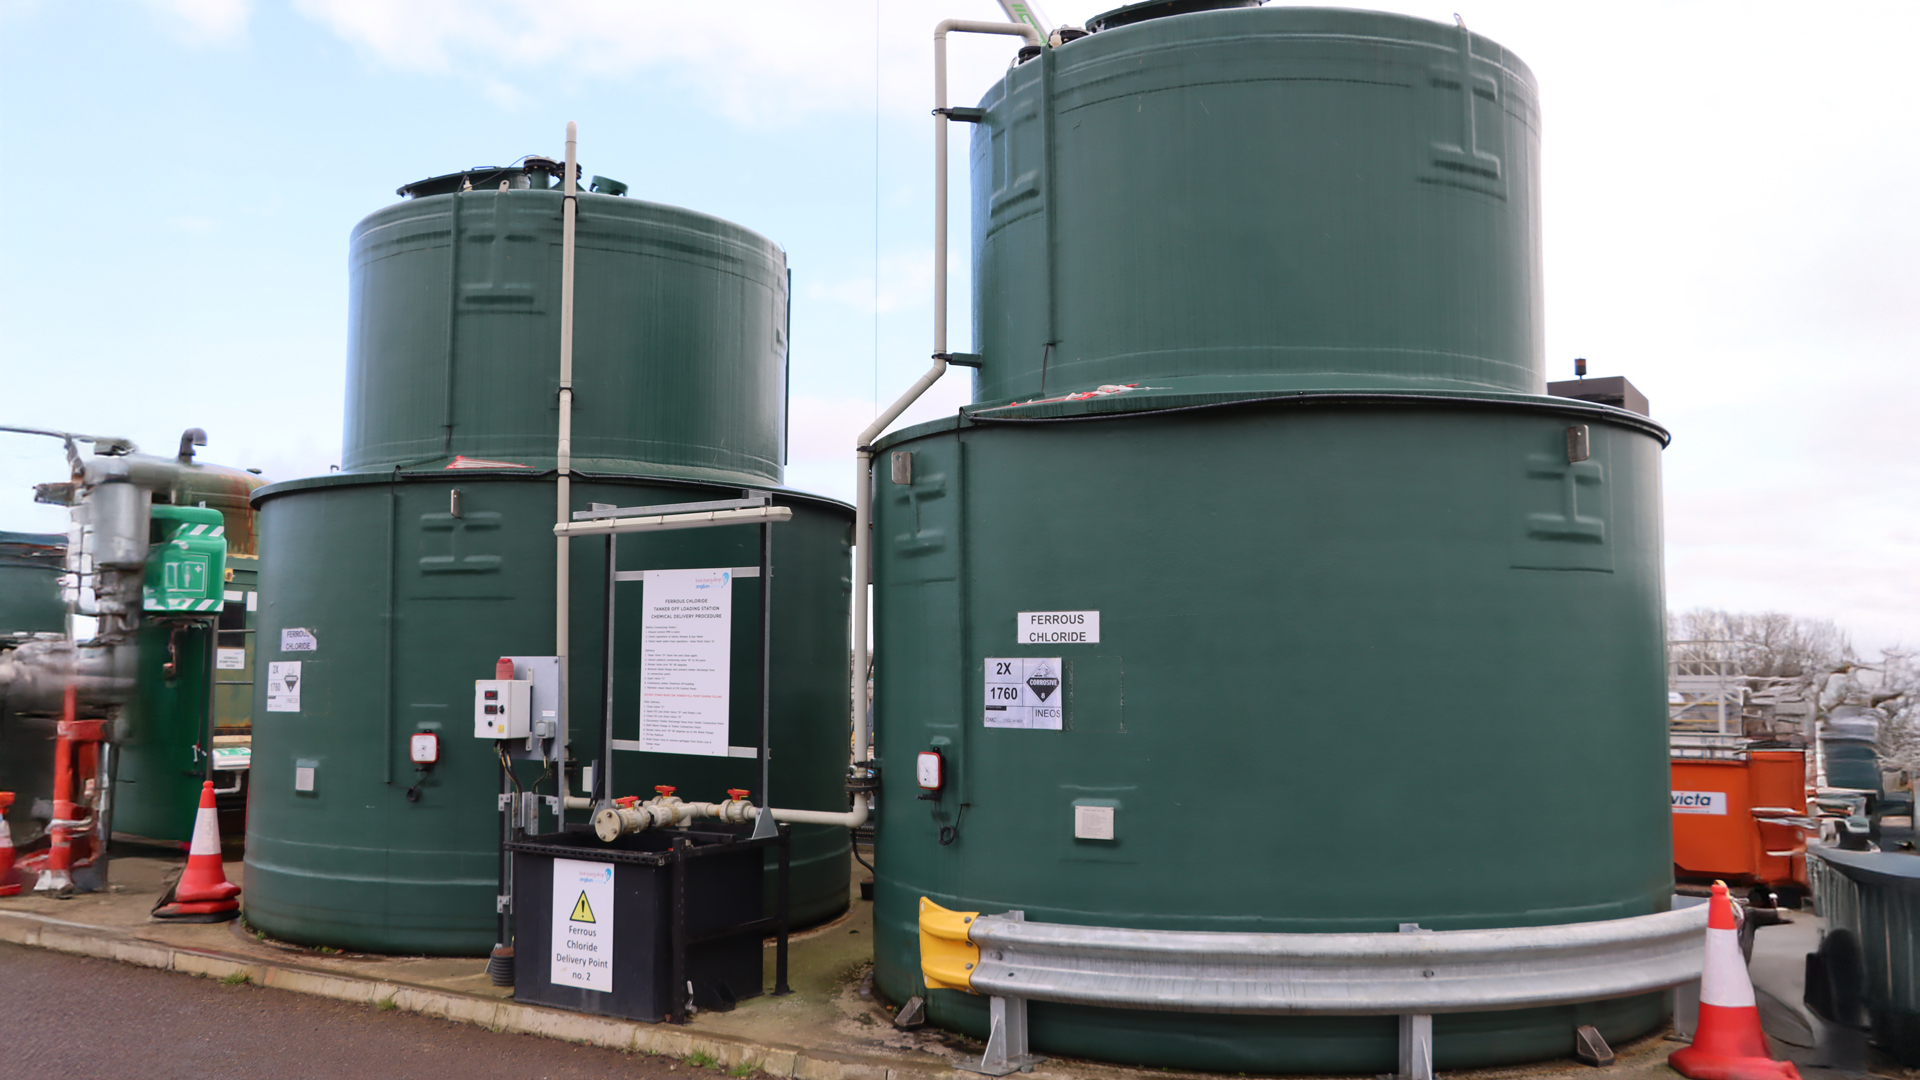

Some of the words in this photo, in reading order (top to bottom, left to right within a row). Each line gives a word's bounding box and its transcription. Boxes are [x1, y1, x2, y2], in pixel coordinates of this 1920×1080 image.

[1030, 614, 1085, 625] FERROUS
[1029, 632, 1086, 642] CHLORIDE
[272, 665, 279, 674] 2X
[996, 662, 1012, 675] 2X
[270, 683, 281, 692] 1760
[990, 687, 1018, 700] 1760
[1035, 709, 1060, 718] INEOS
[568, 925, 596, 937] Ferrous
[566, 940, 598, 952] Chloride
[556, 953, 587, 967] Delivery
[588, 957, 608, 969] Point
[572, 972, 584, 980] no.
[586, 972, 591, 981] 2
